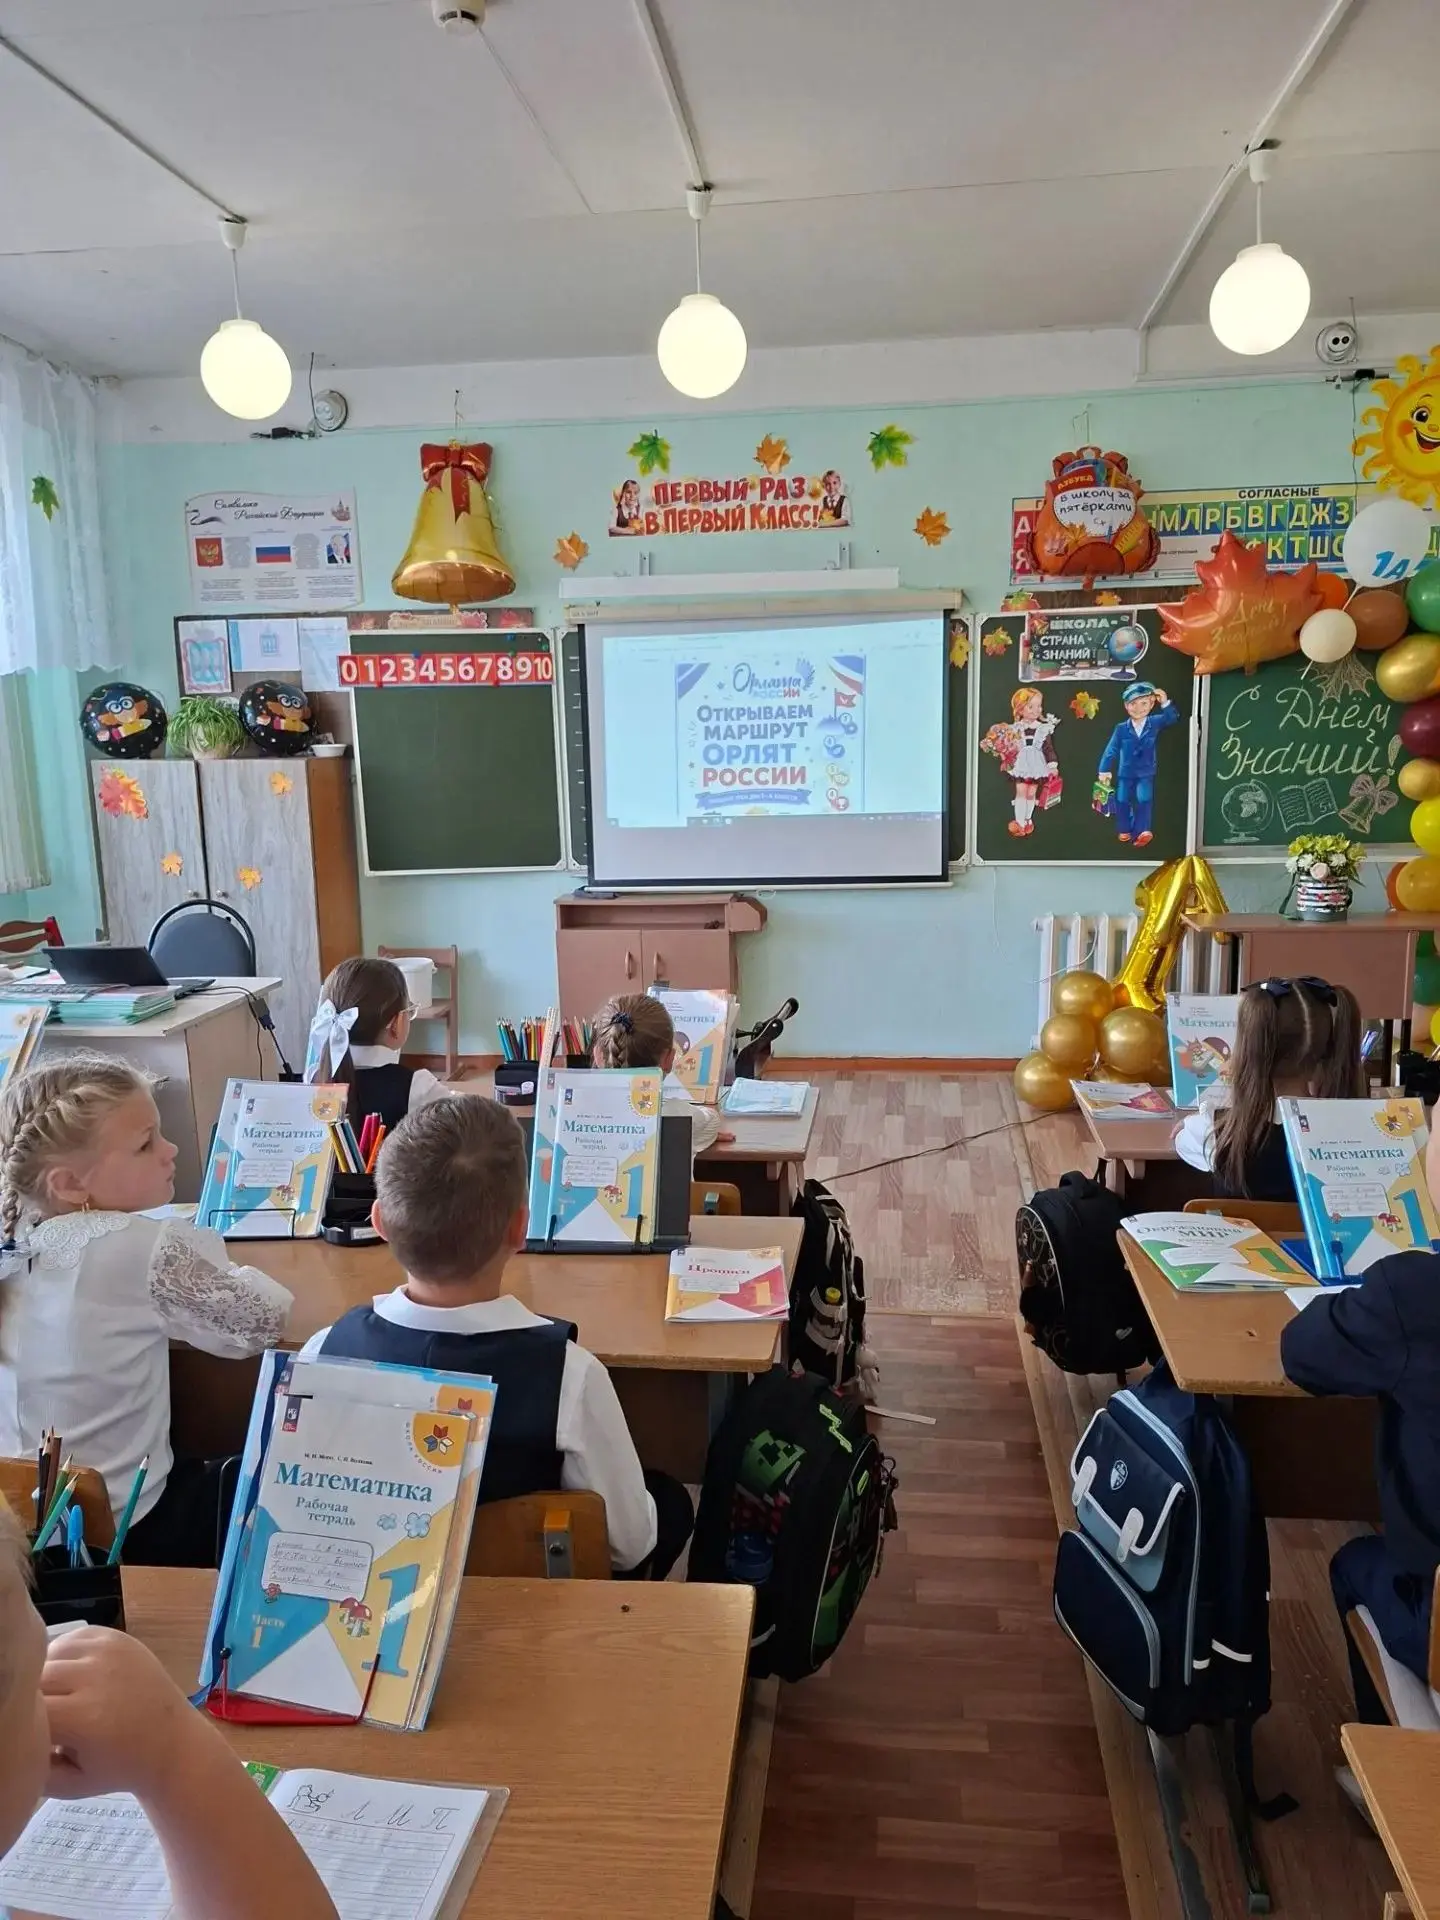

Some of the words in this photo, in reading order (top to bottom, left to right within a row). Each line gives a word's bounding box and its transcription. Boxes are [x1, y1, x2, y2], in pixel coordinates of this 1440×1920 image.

[654, 477, 750, 505] ПЕРВЫЙ
[759, 477, 806, 501] РАЗ
[1238, 487, 1320, 500] СОГЛАСНЫЕ
[644, 511, 660, 536] В
[664, 503, 746, 533] ПЕРВЫЙ
[750, 504, 820, 530] КЛАСС!
[1372, 550, 1411, 579] 1А
[1040, 634, 1085, 646] СТРАНА
[1225, 684, 1262, 731] С
[704, 722, 808, 741] МАРШРУТ
[703, 743, 797, 766] ОРЛЯТ
[703, 766, 807, 787] РОССИИ
[242, 1127, 323, 1139] Математика
[562, 1120, 646, 1134] Математика
[1308, 1148, 1405, 1161] Математика
[622, 1165, 648, 1219] 1
[1393, 1188, 1435, 1250] 1
[274, 1461, 432, 1502] Математика
[296, 1496, 349, 1513] Рабочая
[308, 1511, 355, 1526] тетрадь
[252, 1613, 286, 1629] Часть
[361, 1563, 420, 1678] 1
